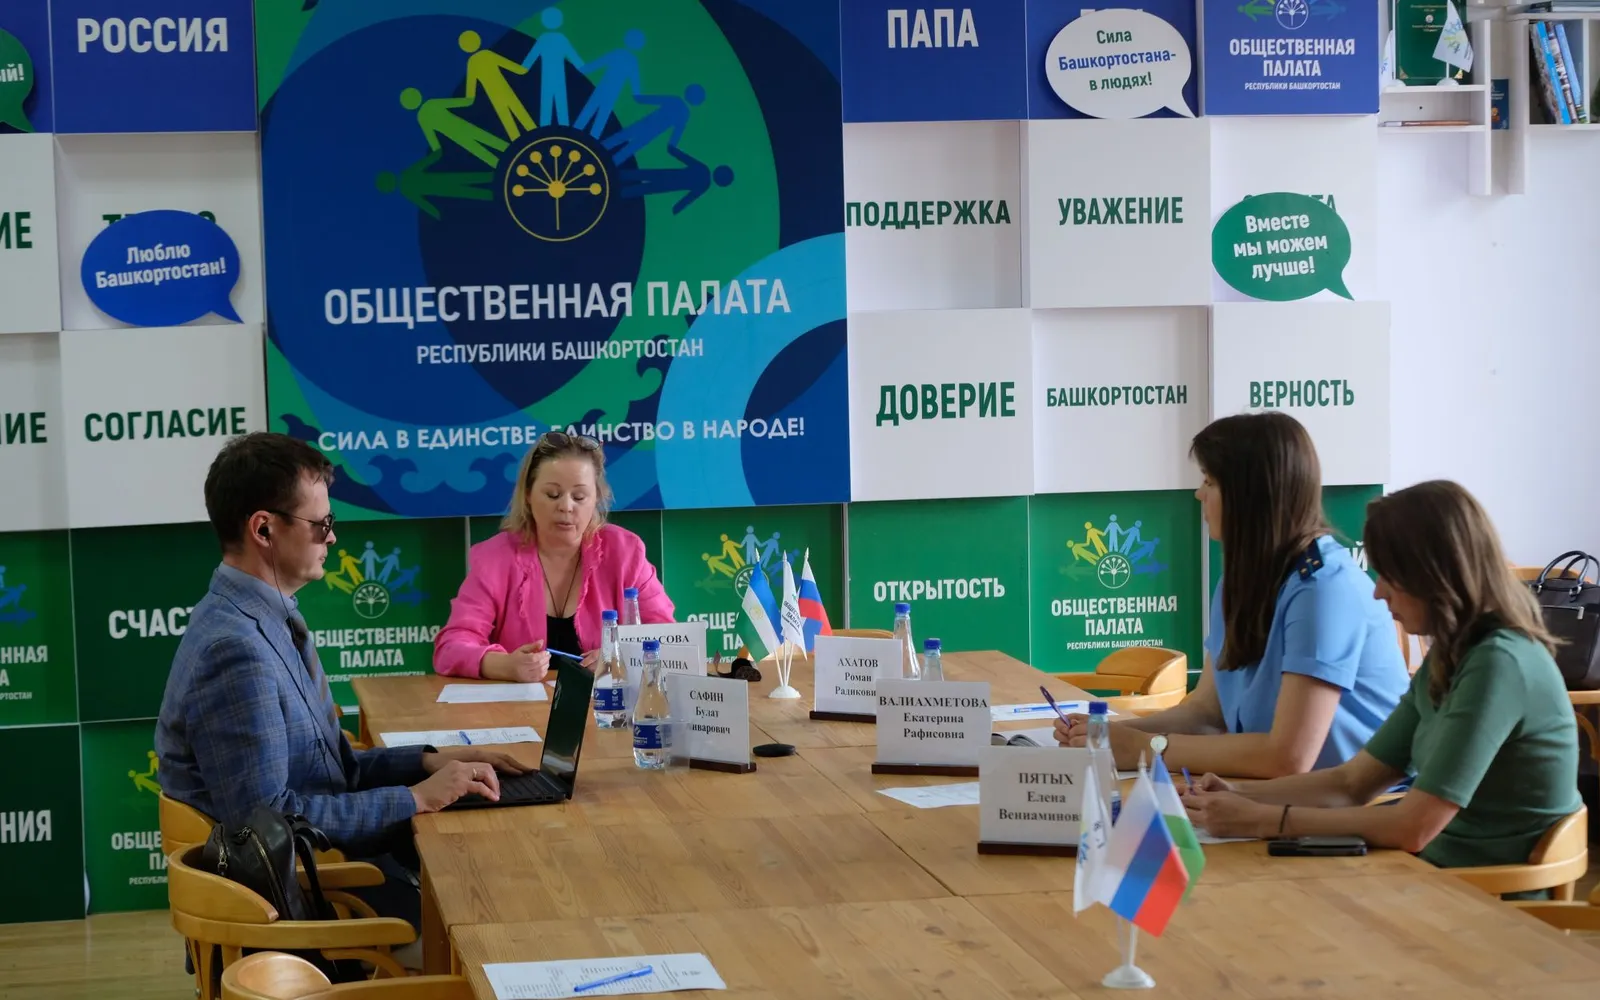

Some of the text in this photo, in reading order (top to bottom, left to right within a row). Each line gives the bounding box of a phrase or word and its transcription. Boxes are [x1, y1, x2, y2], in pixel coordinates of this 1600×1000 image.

[77, 17, 228, 53] РОССИЯ
[887, 8, 979, 48] ПАПА
[1096, 30, 1132, 45] Сила
[1229, 38, 1355, 58] ОБЩЕСТВЕННАЯ
[1058, 47, 1177, 71] Башкортостана-
[1263, 59, 1322, 77] ПАЛАТА
[1089, 72, 1153, 91] в людях!
[1244, 82, 1341, 91] РЕСПУБЛИКИ БАШКОРТОСТАН
[846, 200, 1011, 230] ПОДДЕРЖКА
[1057, 196, 1184, 226] УВАЖЕНИЕ
[1245, 213, 1310, 234] Вместе
[126, 243, 191, 265] Люблю
[1233, 235, 1328, 258] мы можем
[95, 257, 227, 288] Башкортостан!
[1251, 256, 1316, 282] лучше!
[324, 278, 792, 330] ОБЩЕСТВЕННАЯ ПАЛАТА
[416, 338, 704, 365] РЕСПУБЛИКИ БАШКОРТОСТАН
[1046, 384, 1188, 407] БАШКОРТОСТАН
[1249, 379, 1355, 408] ВЕРНОСТЬ
[875, 381, 1016, 427] ДОВЕРИЕ
[84, 406, 247, 442] СОГЛАСИЕ
[318, 430, 388, 452] СИЛА
[396, 430, 409, 449] В
[417, 425, 536, 450] ЕДИНСТВЕ
[682, 420, 695, 440] В
[702, 417, 805, 440] НАРОДЕ!
[873, 577, 1006, 602] ОТКРЫТОСТЬ
[1051, 595, 1178, 616] ОБЩЕСТВЕННАЯ
[1084, 617, 1144, 636] ПАЛАТА
[1066, 638, 1163, 650] РЕСПУБЛИКИ БАШКОРТОСТАН
[340, 649, 405, 669] ПАЛАТА
[630, 657, 689, 670] ПАХИНА
[837, 657, 879, 668] АХАТОВ
[844, 672, 872, 682] Роман
[689, 690, 724, 702] САФИН
[835, 685, 877, 697] Радикови
[879, 696, 988, 708] ВАЛИАХМЕТОВА
[695, 706, 720, 719] Булат
[903, 712, 964, 726] Екатерина
[903, 728, 965, 741] Рафисовна
[1018, 772, 1074, 785] ПЯТЫХ
[1027, 791, 1066, 803] Елена
[999, 808, 1081, 822] Вениаминов
